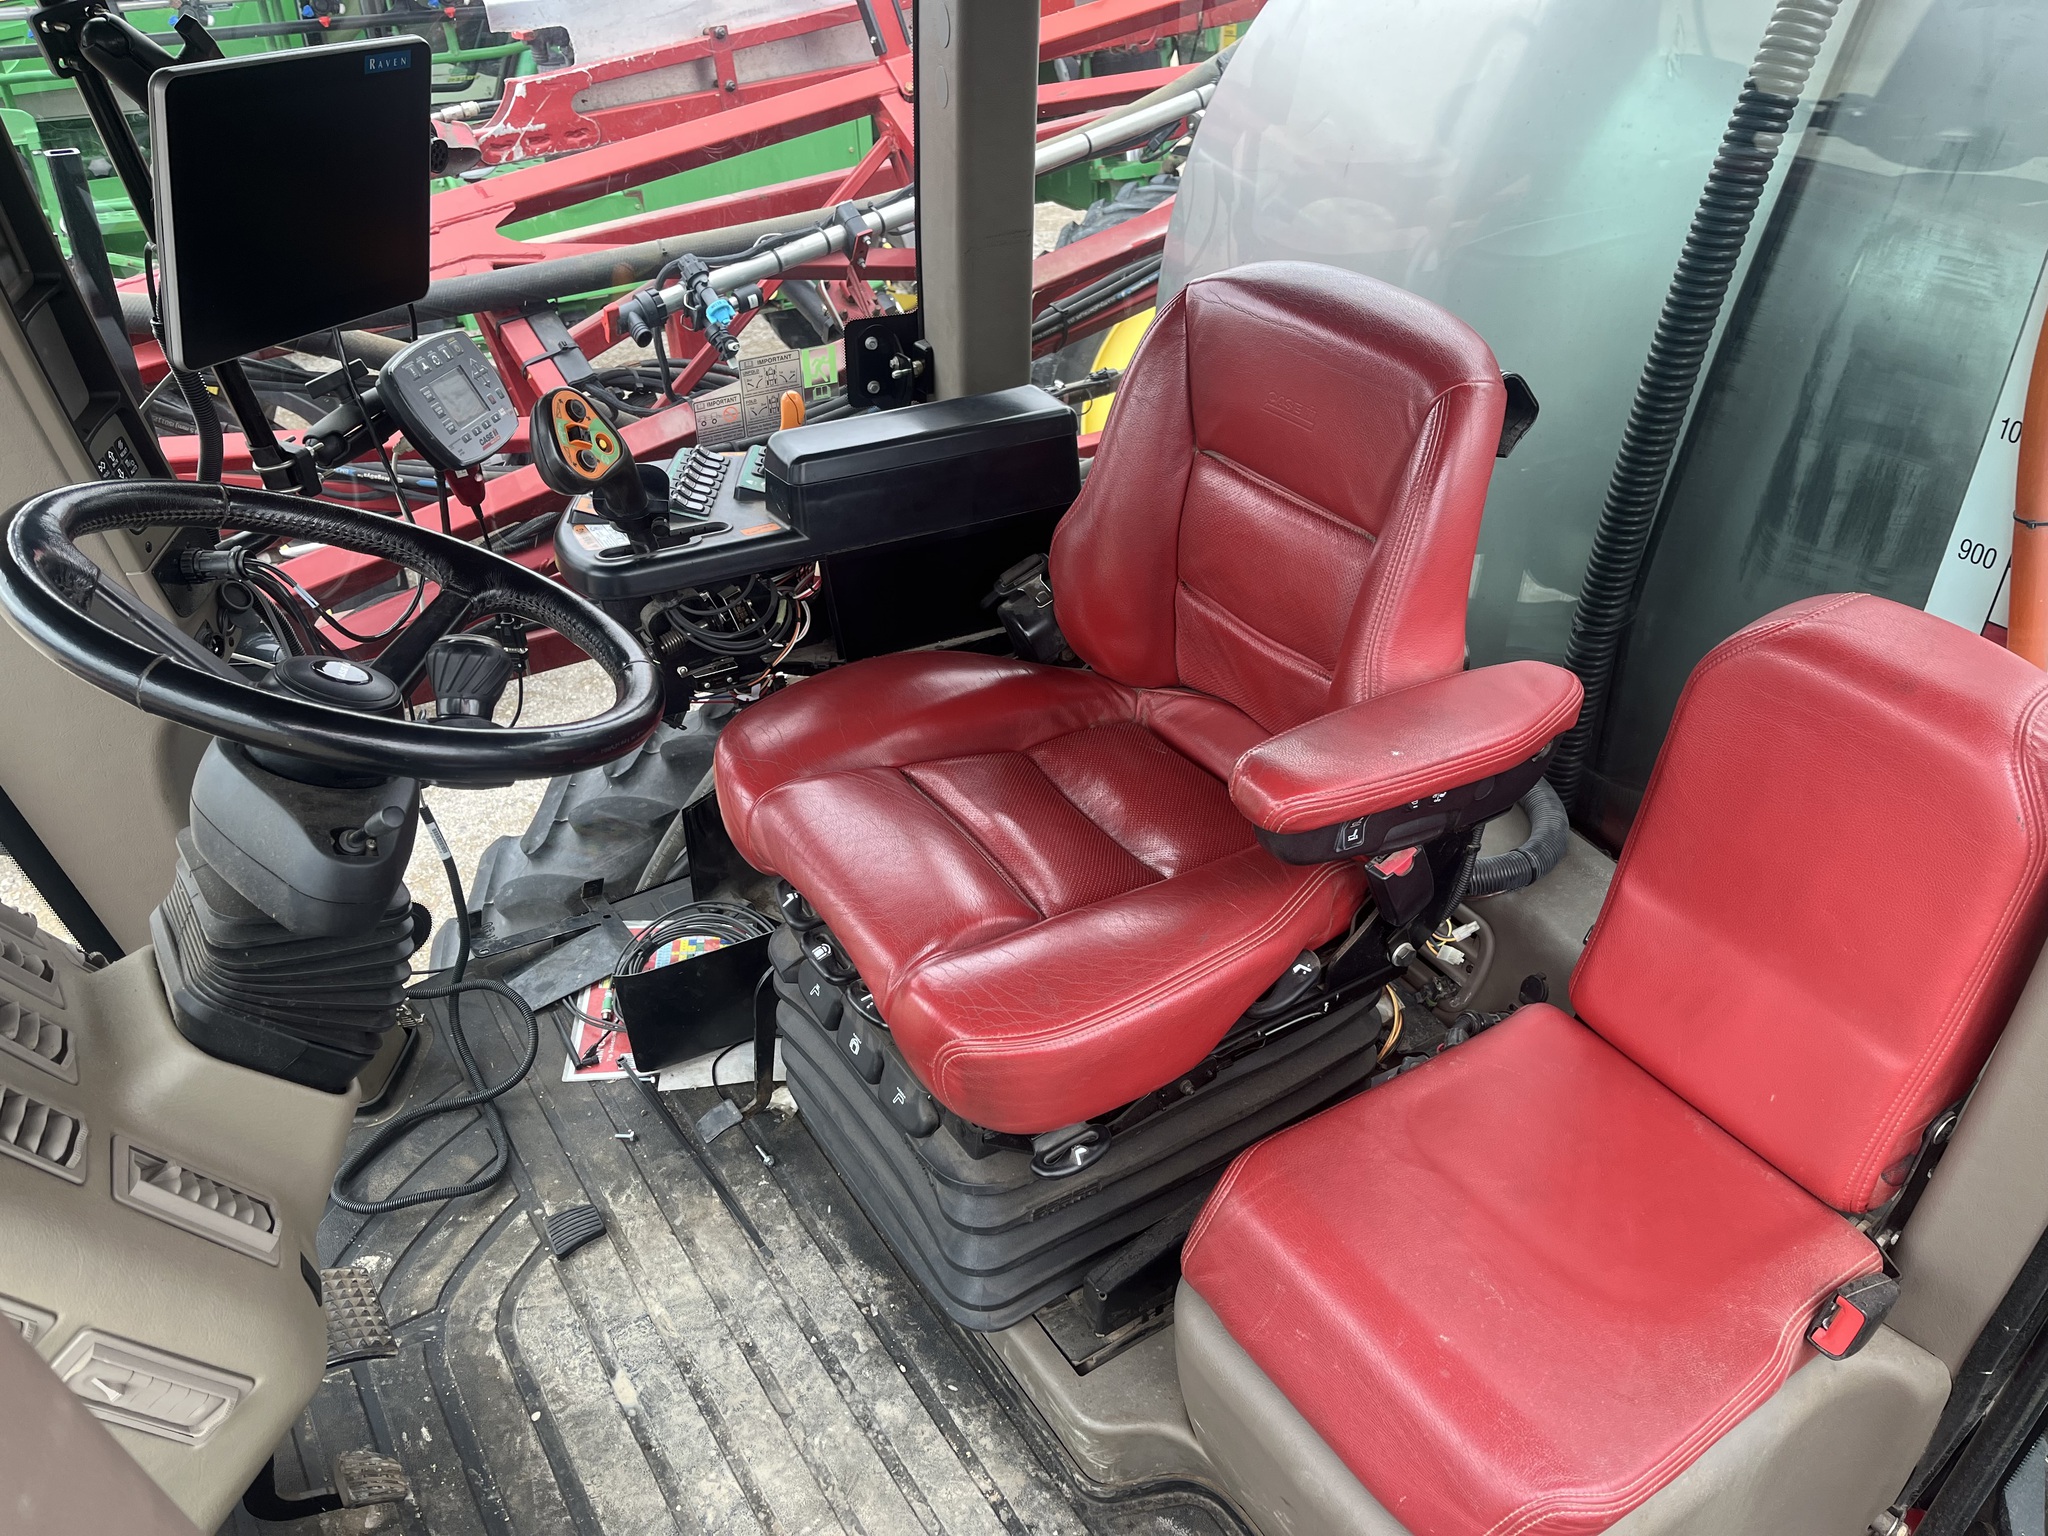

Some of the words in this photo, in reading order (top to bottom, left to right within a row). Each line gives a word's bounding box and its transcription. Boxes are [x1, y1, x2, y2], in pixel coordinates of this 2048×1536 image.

[369, 57, 407, 70] RAVEN
[757, 353, 792, 365] IMPORTANT
[706, 396, 738, 407] IMPORTANT
[479, 431, 494, 446] CASE
[1958, 539, 1997, 569] 900
